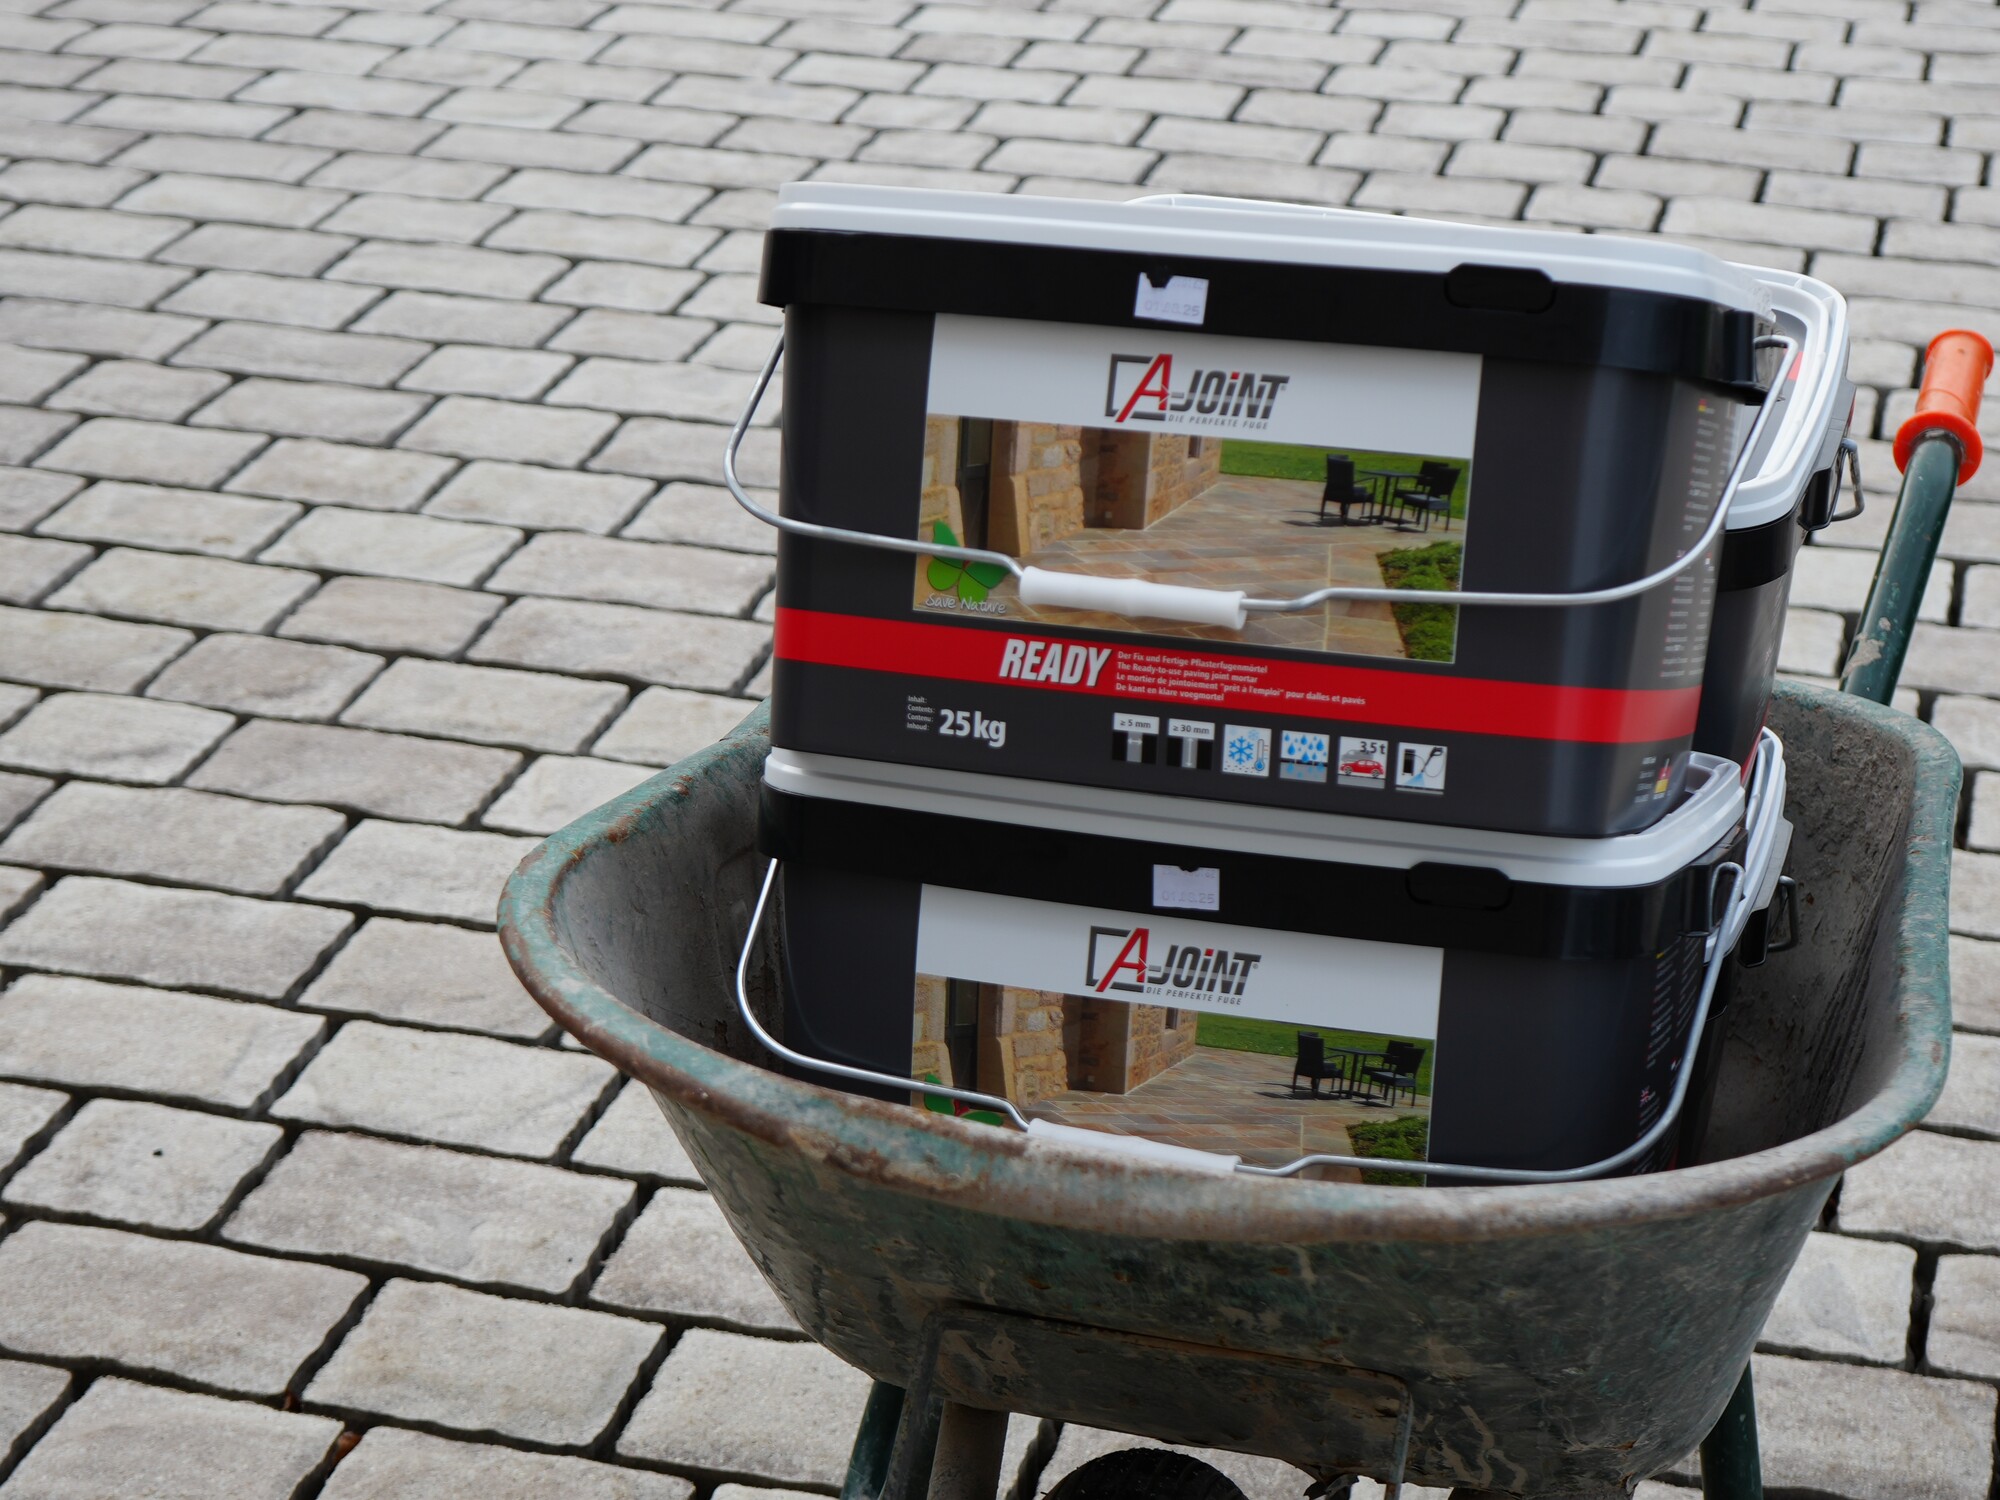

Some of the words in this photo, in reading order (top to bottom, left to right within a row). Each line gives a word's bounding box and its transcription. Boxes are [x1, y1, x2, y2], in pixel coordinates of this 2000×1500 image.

[1168, 414, 1184, 423] DIE
[1189, 416, 1238, 428] PERFEKTE
[1243, 420, 1268, 430] FUGE
[926, 593, 956, 608] Save
[960, 596, 1006, 613] Nature
[999, 638, 1112, 686] READY
[1118, 651, 1131, 660] Der
[1134, 652, 1144, 661] Fix
[1146, 653, 1160, 662] und
[1162, 655, 1188, 666] Fertige
[1190, 658, 1268, 674] Pflasterfugenmörtel
[1117, 662, 1130, 670] The
[1133, 664, 1181, 676] Ready-to-use
[1184, 668, 1210, 680] paving
[1212, 670, 1230, 680] joint
[1232, 674, 1258, 683] mortar
[1116, 672, 1126, 680] Le
[1127, 673, 1155, 683] mortier
[1157, 676, 1166, 684] de
[1168, 677, 1218, 690] jointoiement
[1286, 690, 1304, 699] pour
[1306, 692, 1330, 701] dalles
[1332, 694, 1340, 702] et
[1342, 695, 1366, 705] pavés
[1116, 682, 1126, 691] De
[1128, 684, 1145, 693] kant
[1147, 686, 1156, 694] en
[1158, 687, 1178, 696] klare
[1180, 690, 1224, 701] voegmortel
[1134, 721, 1152, 729] mm
[1180, 724, 1191, 733] 30
[1193, 727, 1210, 735] mm
[1146, 986, 1161, 995] DIE
[1166, 989, 1212, 1002] PERFEKTE
[1218, 996, 1242, 1006] FUGE
